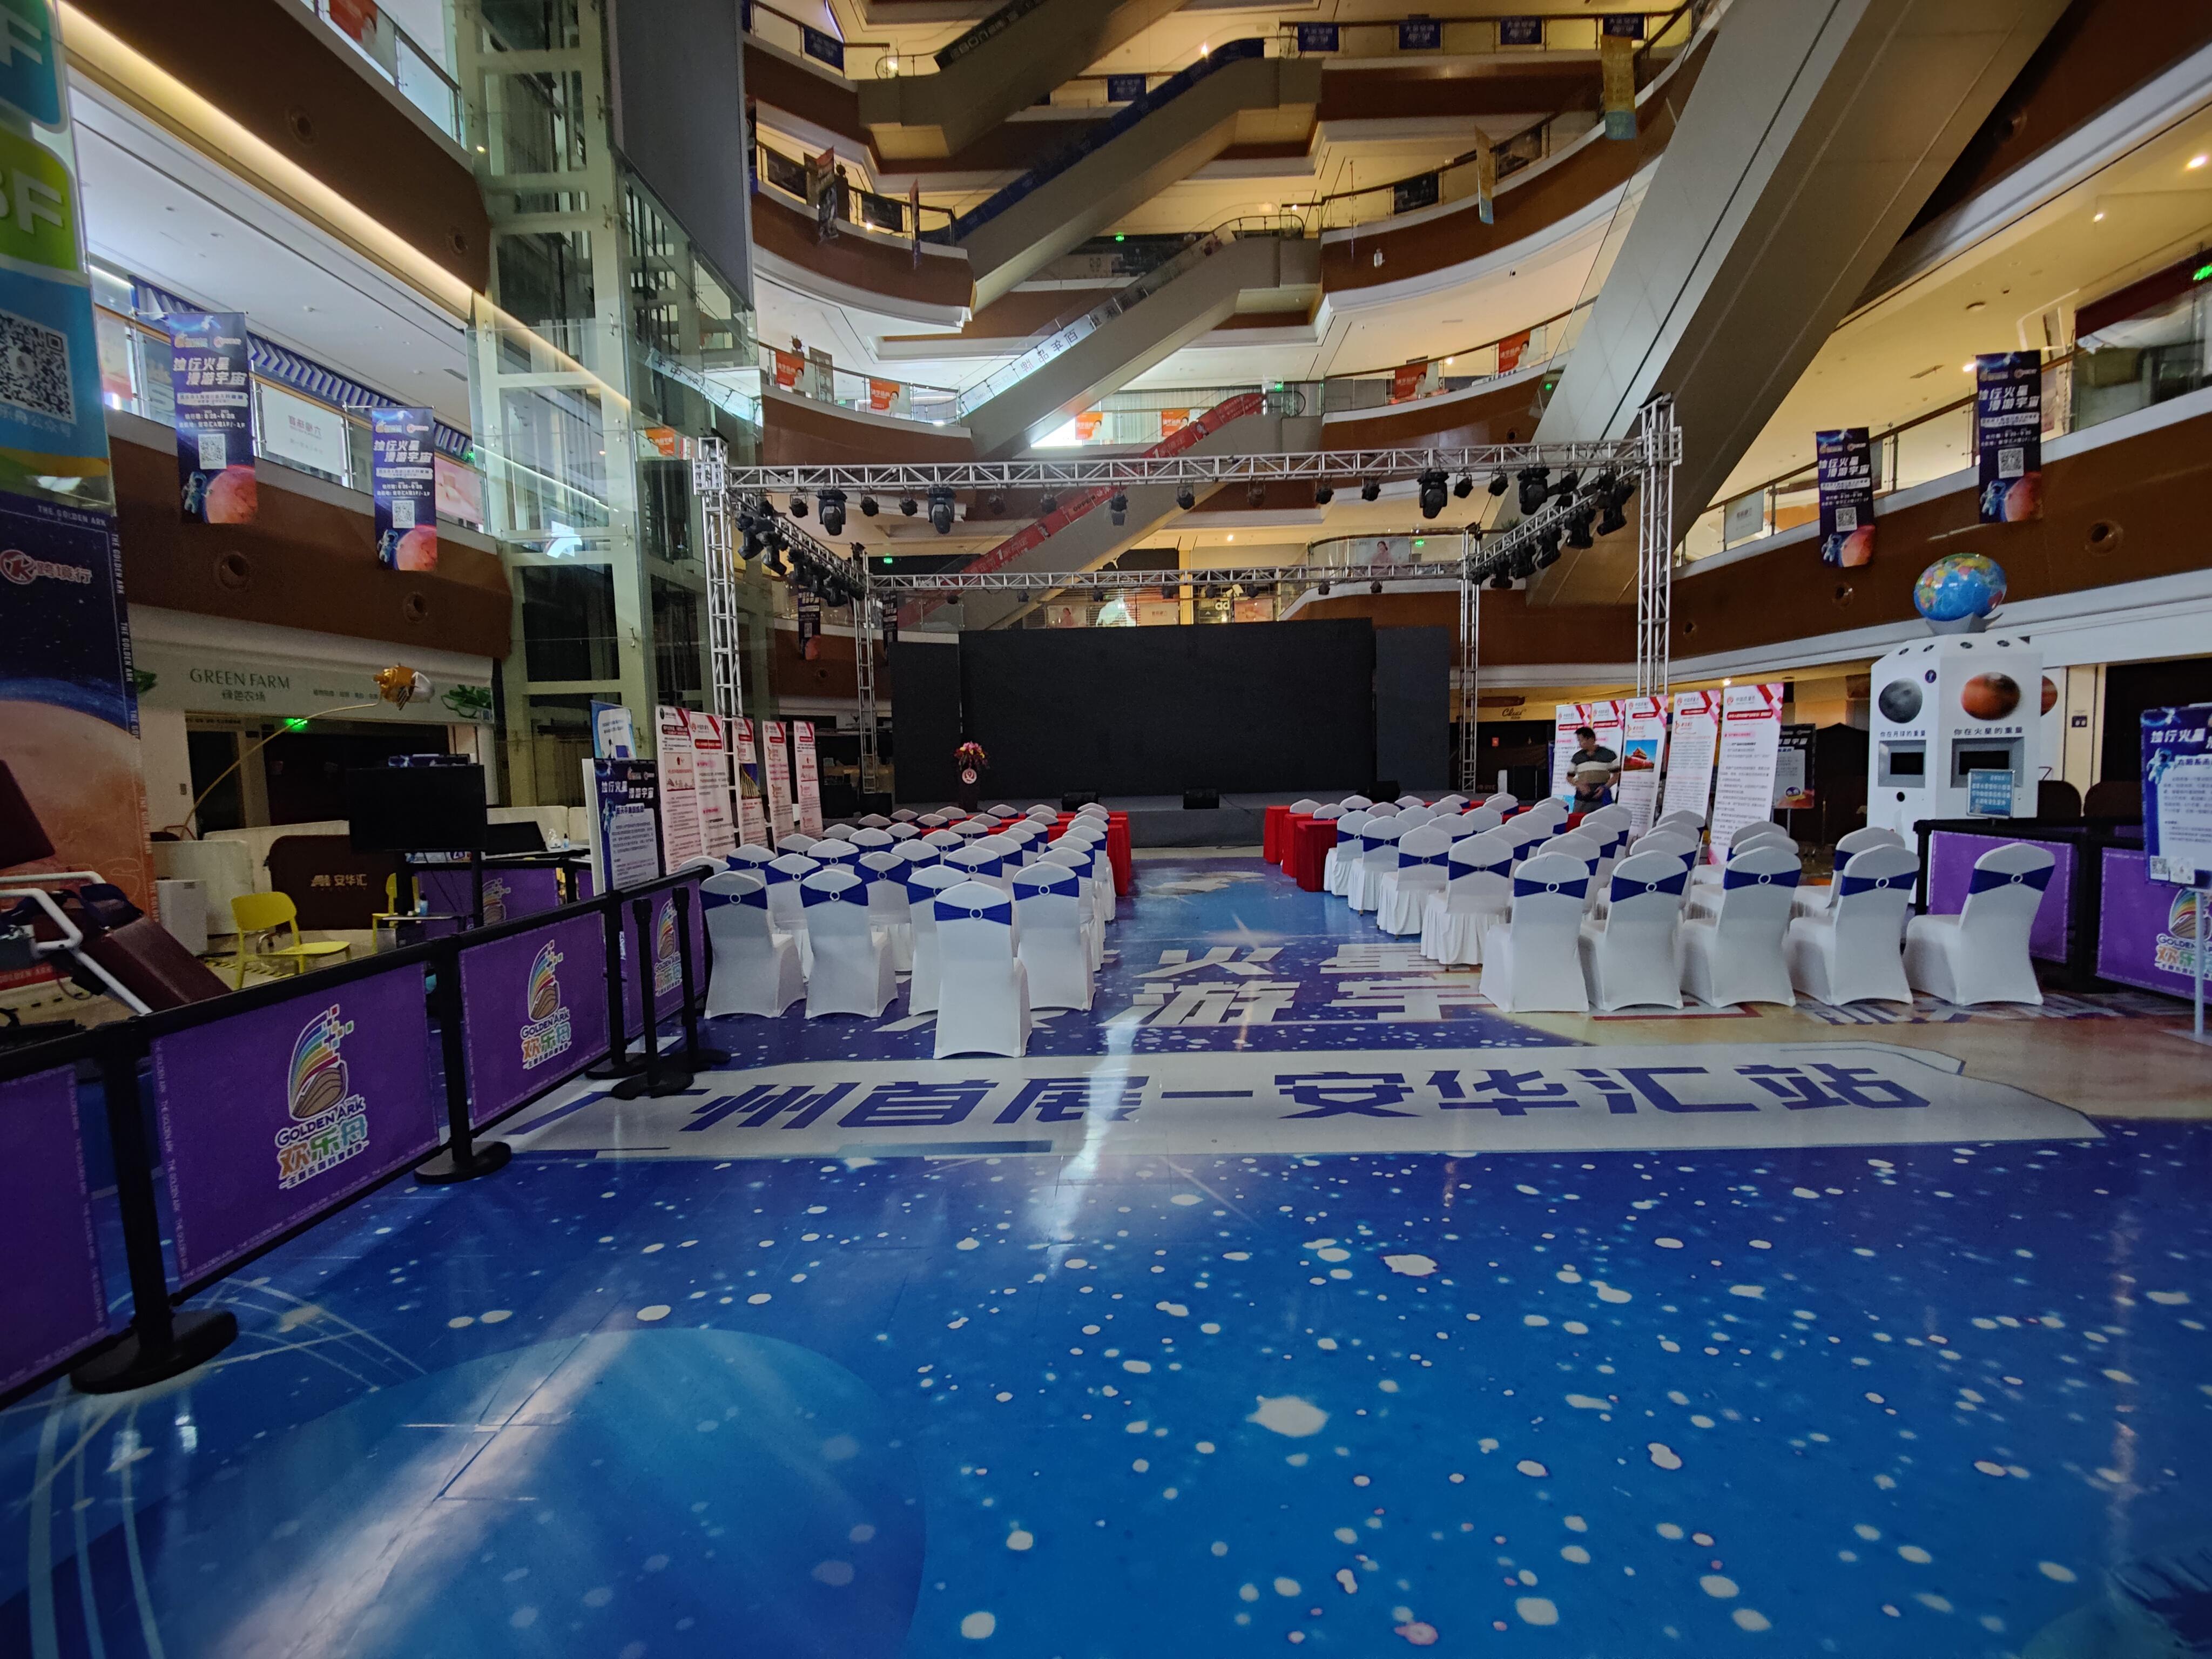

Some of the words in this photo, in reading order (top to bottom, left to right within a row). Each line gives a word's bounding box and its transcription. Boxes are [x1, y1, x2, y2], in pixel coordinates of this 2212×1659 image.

[0, 166, 64, 235] F
[38, 504, 53, 515] THE
[57, 508, 89, 523] GOLDEN
[91, 516, 106, 527] ARK
[113, 549, 123, 577] GOLDEN
[116, 579, 125, 595] ARK
[120, 623, 128, 635] THE
[123, 637, 132, 665] GOLDEN
[125, 668, 134, 682] ARK
[190, 667, 246, 686] GREEN
[251, 673, 290, 690] FARM
[1954, 726, 2024, 736] 你在火星的重量
[334, 874, 368, 886] 安华汇
[522, 1019, 553, 1038] GOLDEN
[554, 1012, 569, 1024] ARK
[277, 1111, 335, 1146] GOLDEN
[336, 1099, 366, 1121] ARK
[279, 1115, 366, 1177] 欢乐舟
